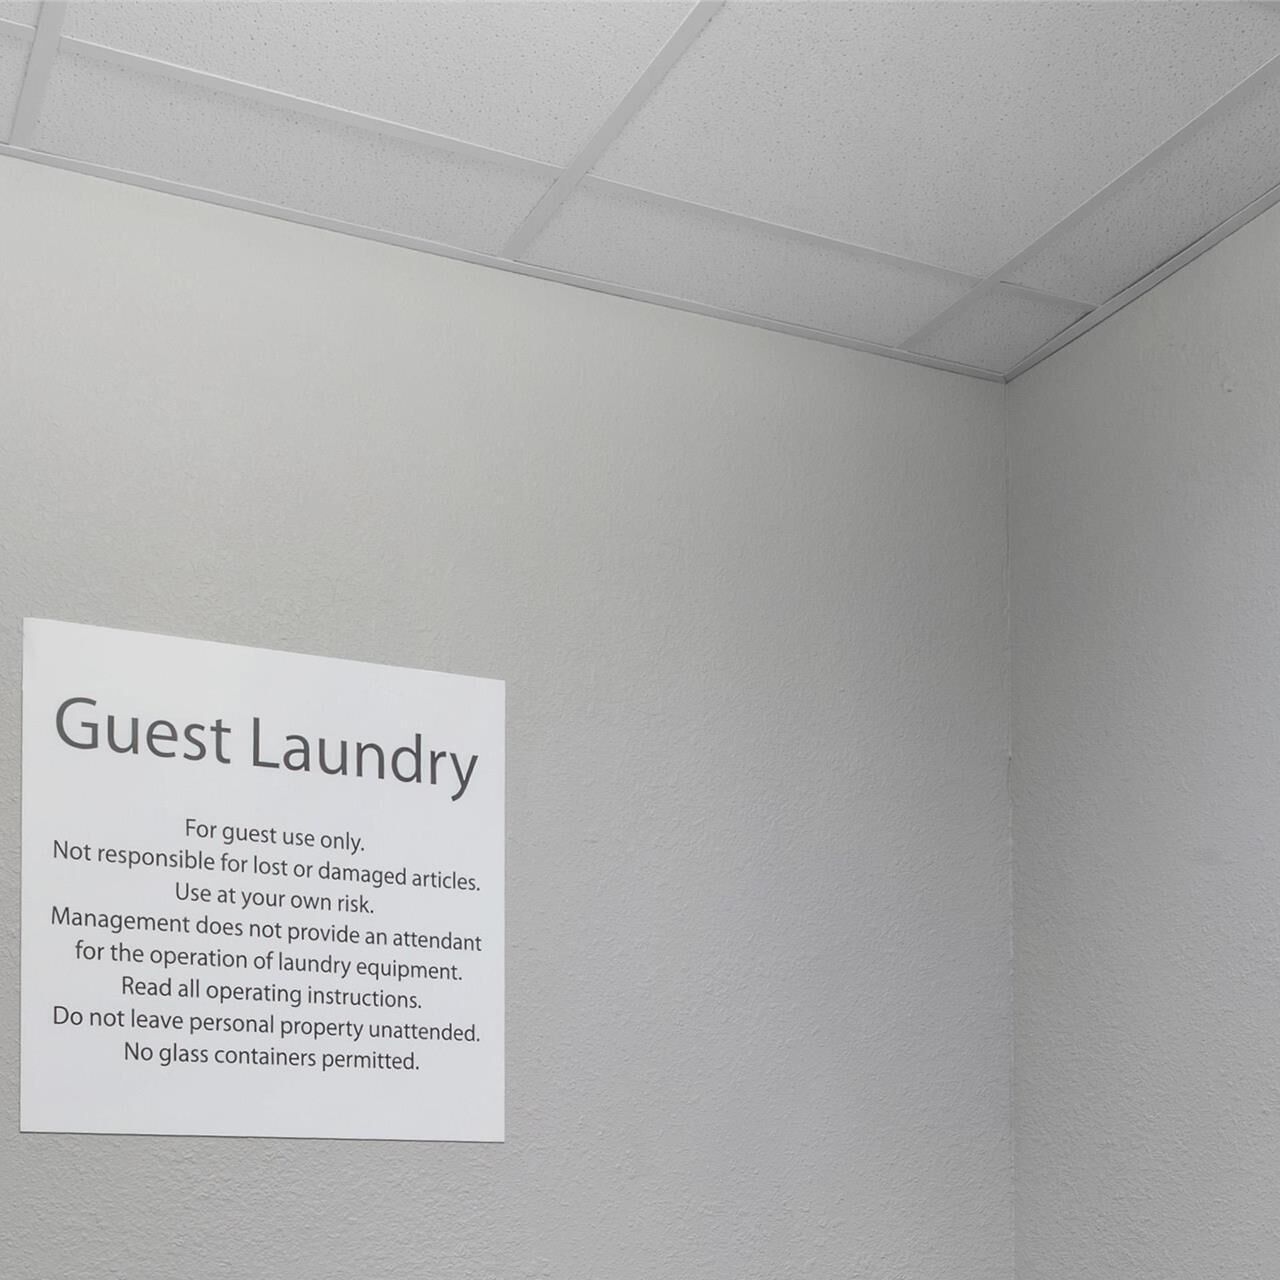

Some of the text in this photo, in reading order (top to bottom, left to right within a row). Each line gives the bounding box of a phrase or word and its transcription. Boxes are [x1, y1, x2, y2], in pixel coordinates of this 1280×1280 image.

[55, 696, 479, 803] Guest Laundry
[185, 817, 365, 857] For guest use only.
[52, 839, 481, 892] Not responsible for lost or damaged articles.
[175, 881, 375, 915] Use at your own risk.
[51, 905, 483, 952] Management does not provide an attendant
[74, 938, 463, 983] for the operation of laundry equipment.
[121, 975, 423, 1009] Read all operating instructions.
[53, 1005, 481, 1043] Do not leave personal property unattended.
[124, 1040, 420, 1073] No glass containers permitted.
